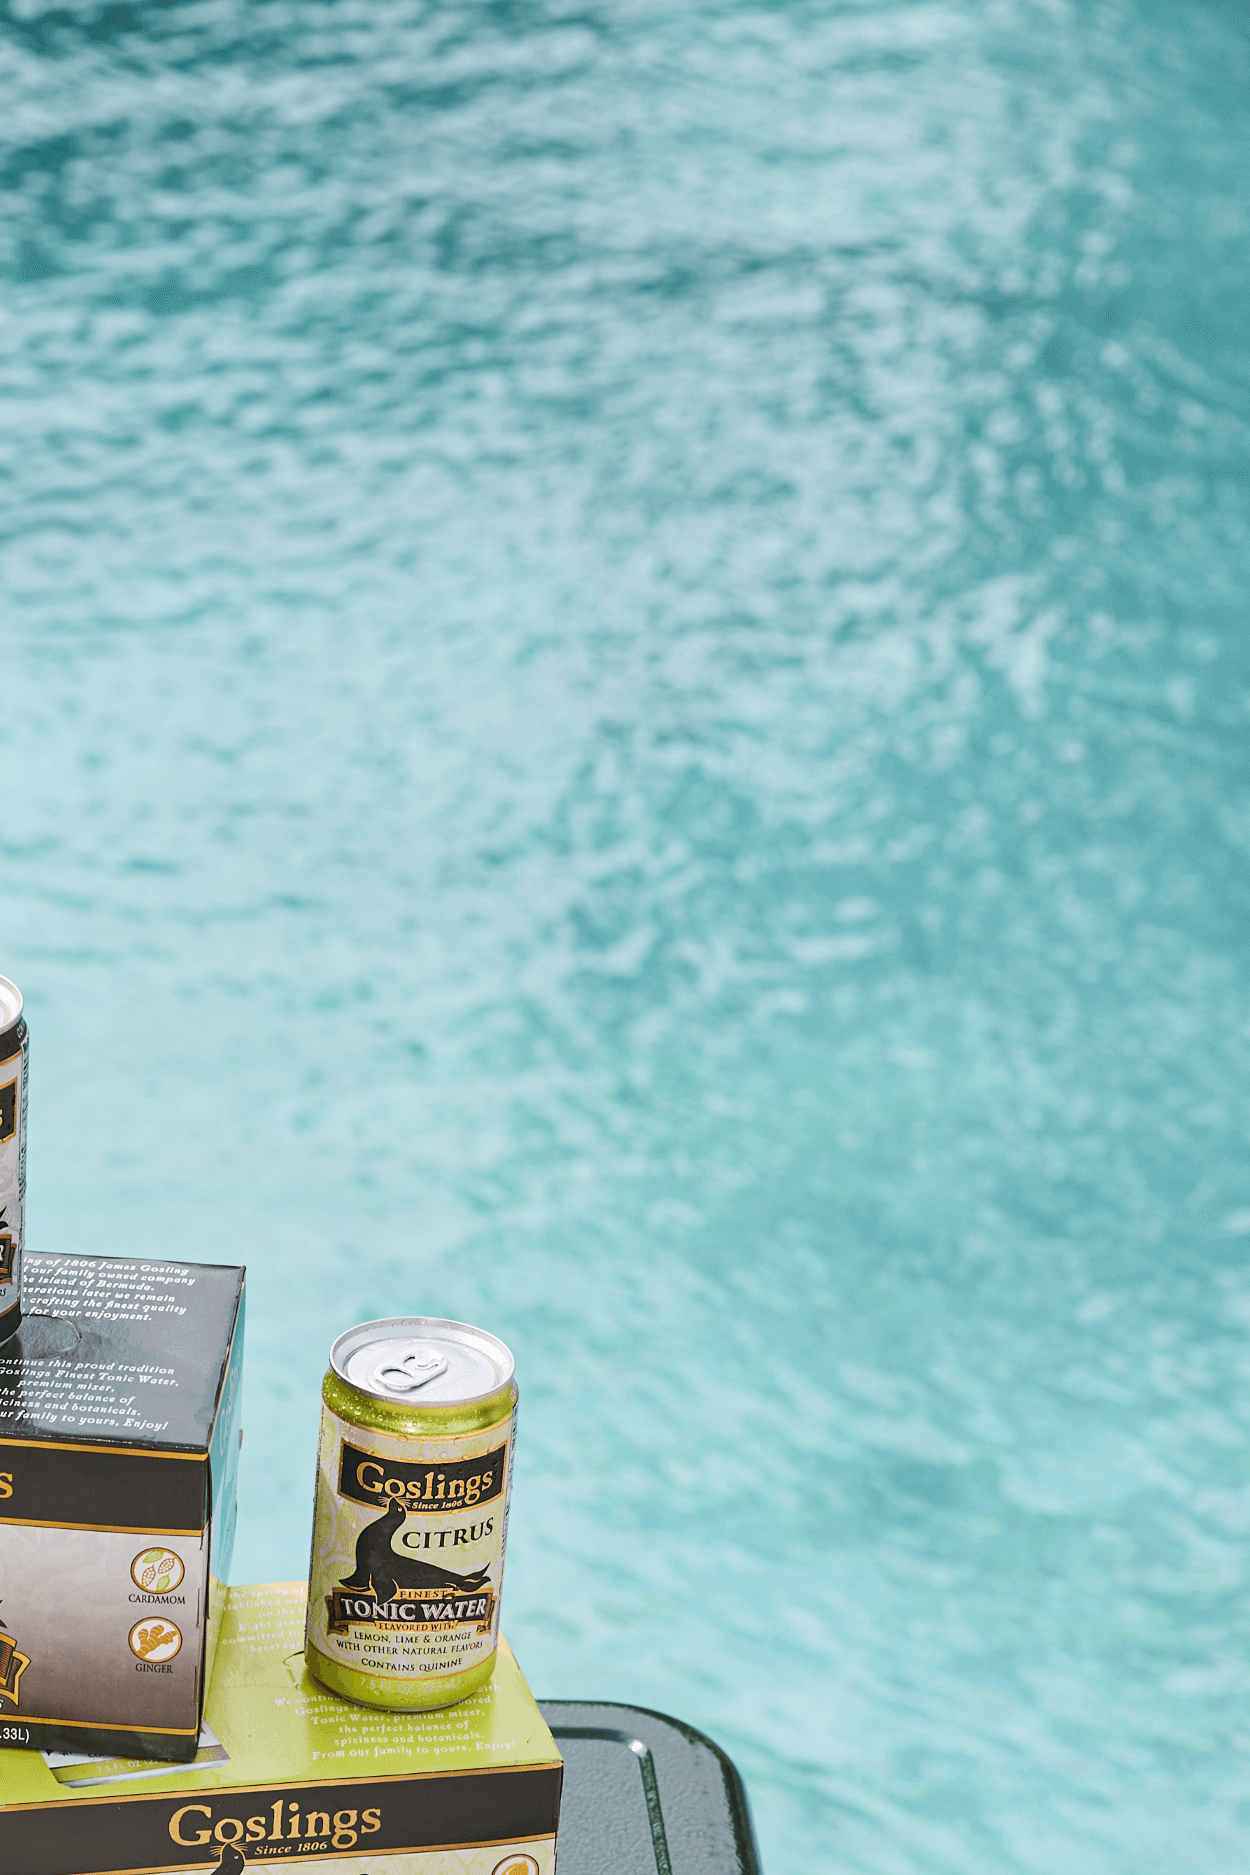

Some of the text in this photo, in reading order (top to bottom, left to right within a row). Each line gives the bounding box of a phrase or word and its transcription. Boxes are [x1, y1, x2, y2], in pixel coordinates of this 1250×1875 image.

[64, 1259, 189, 1276] 1806 James Gosling
[15, 1411, 57, 1423] family
[62, 1414, 75, 1422] to
[124, 1418, 169, 1431] Enjoy!
[357, 1462, 493, 1504] Goslings
[402, 1517, 494, 1548] CITRUS
[128, 1594, 186, 1604] CARDAMOM
[341, 1598, 487, 1620] TONIC WATER
[354, 1632, 471, 1643] LEMON, LIME ORANGE
[336, 1640, 360, 1651] WITH
[364, 1645, 398, 1654] OTHER
[451, 1641, 483, 1652] FLAVORS
[135, 1663, 172, 1673] GINGER
[169, 1800, 381, 1849] Goslings
[255, 1841, 328, 1855] Since 1806
